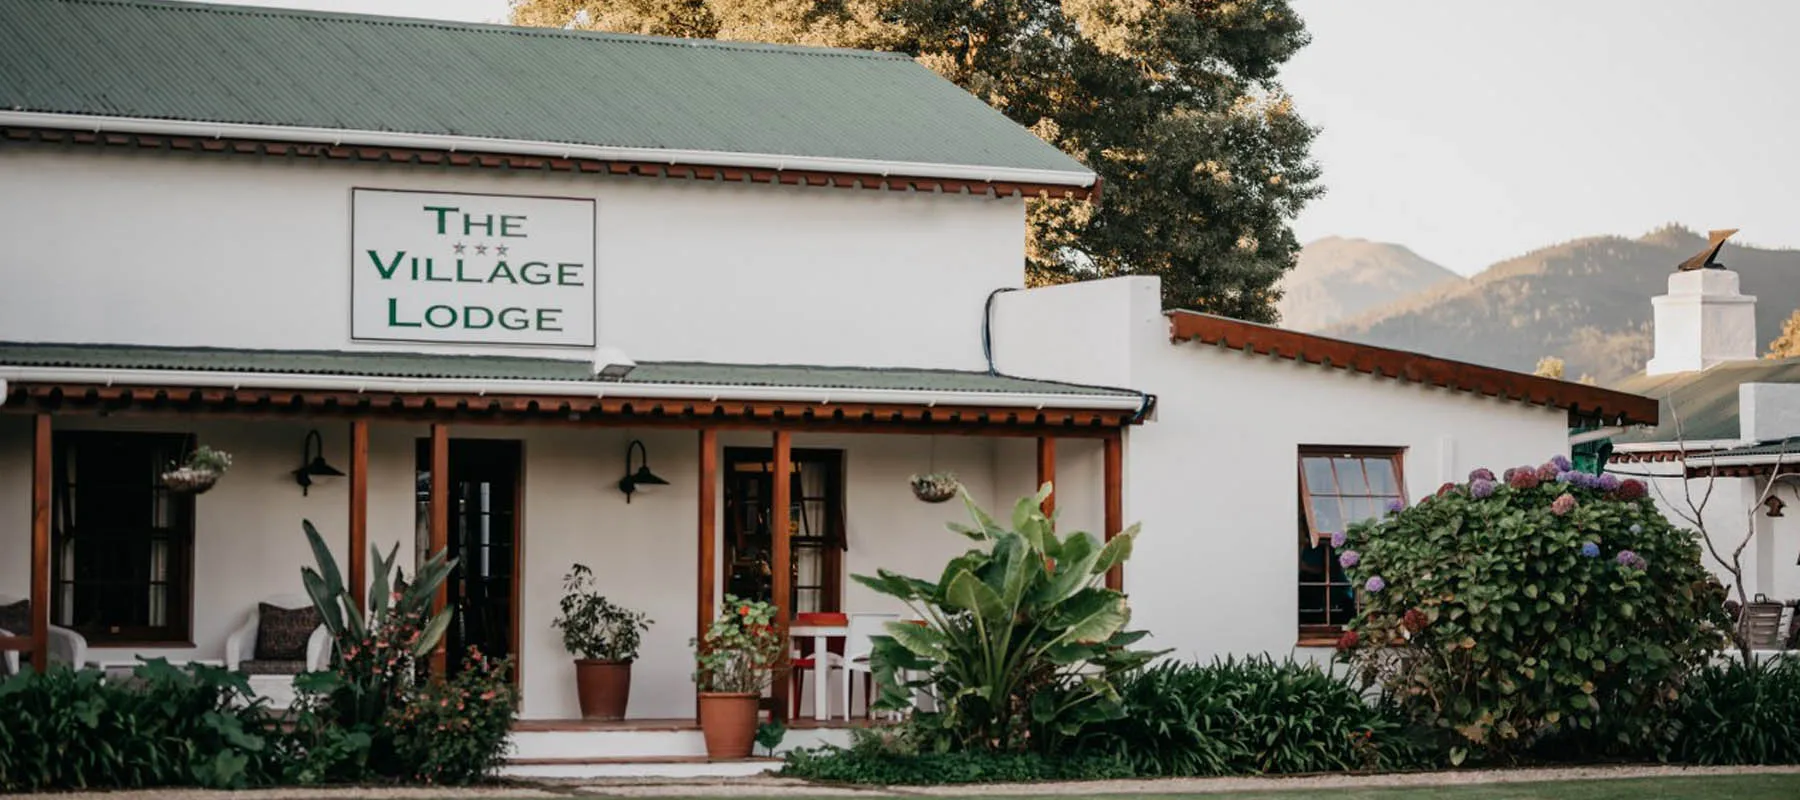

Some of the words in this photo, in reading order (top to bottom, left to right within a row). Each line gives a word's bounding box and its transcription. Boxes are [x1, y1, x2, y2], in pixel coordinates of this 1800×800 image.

[423, 206, 528, 238] THE
[366, 250, 585, 287] VILLAGE
[387, 298, 563, 332] LODGE
